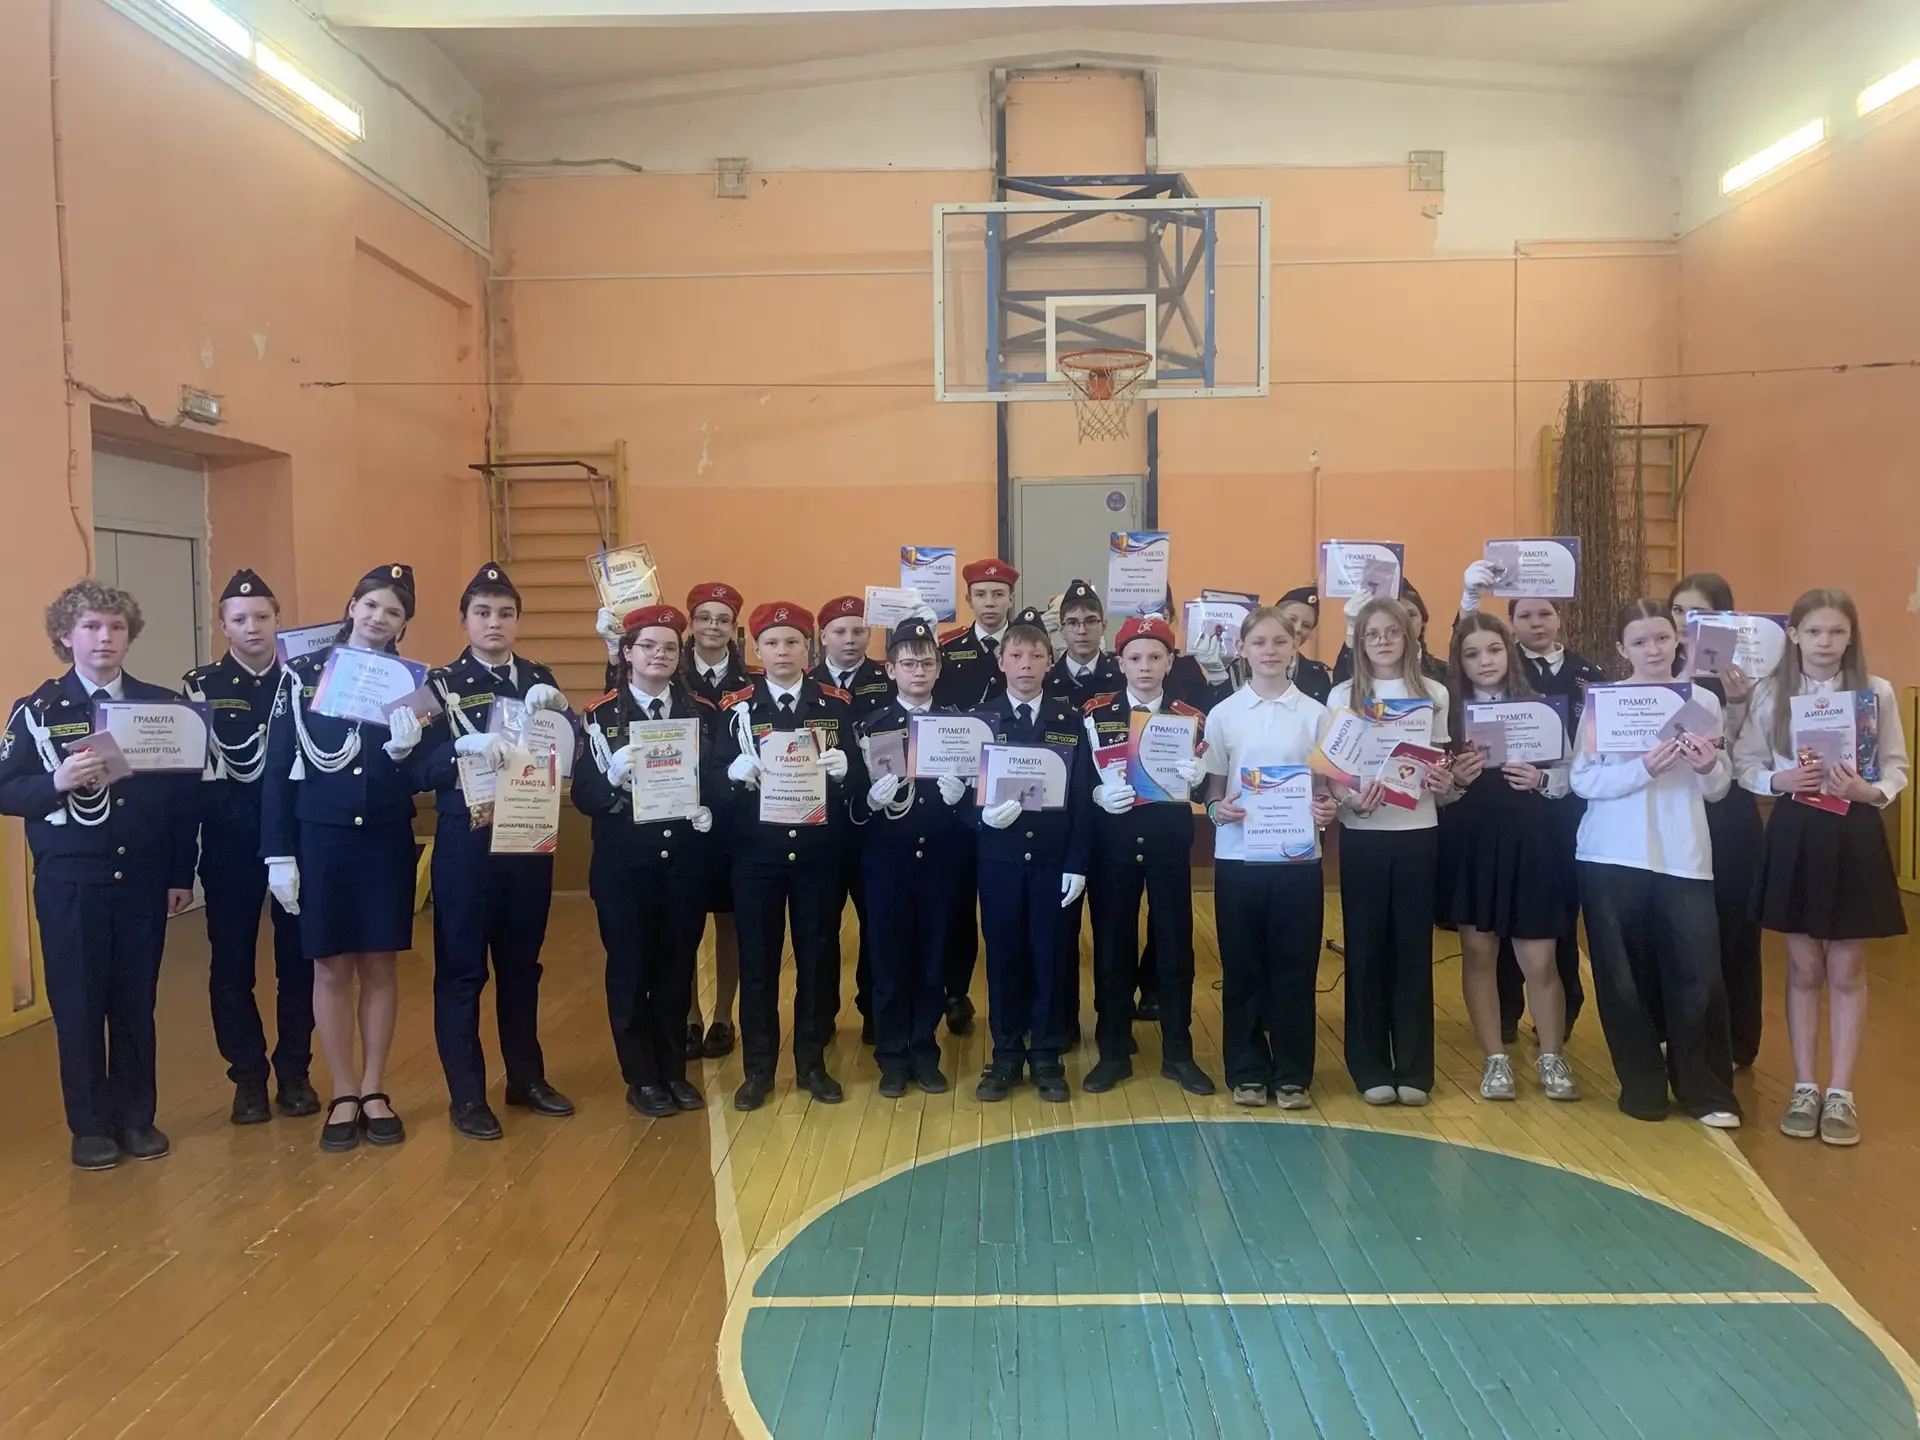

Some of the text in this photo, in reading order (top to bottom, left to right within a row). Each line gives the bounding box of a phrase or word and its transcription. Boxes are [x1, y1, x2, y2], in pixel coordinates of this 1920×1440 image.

[1804, 709, 1843, 718] ДИПЛОМ
[133, 715, 175, 724] ГРАМОТА
[1150, 725, 1189, 734] ГРАМОТА
[1328, 719, 1353, 756] ГРАМОТА
[162, 746, 181, 754] ГОДА
[1009, 757, 1042, 765] ГРАМОТА
[510, 779, 546, 787] ГРАМОТА
